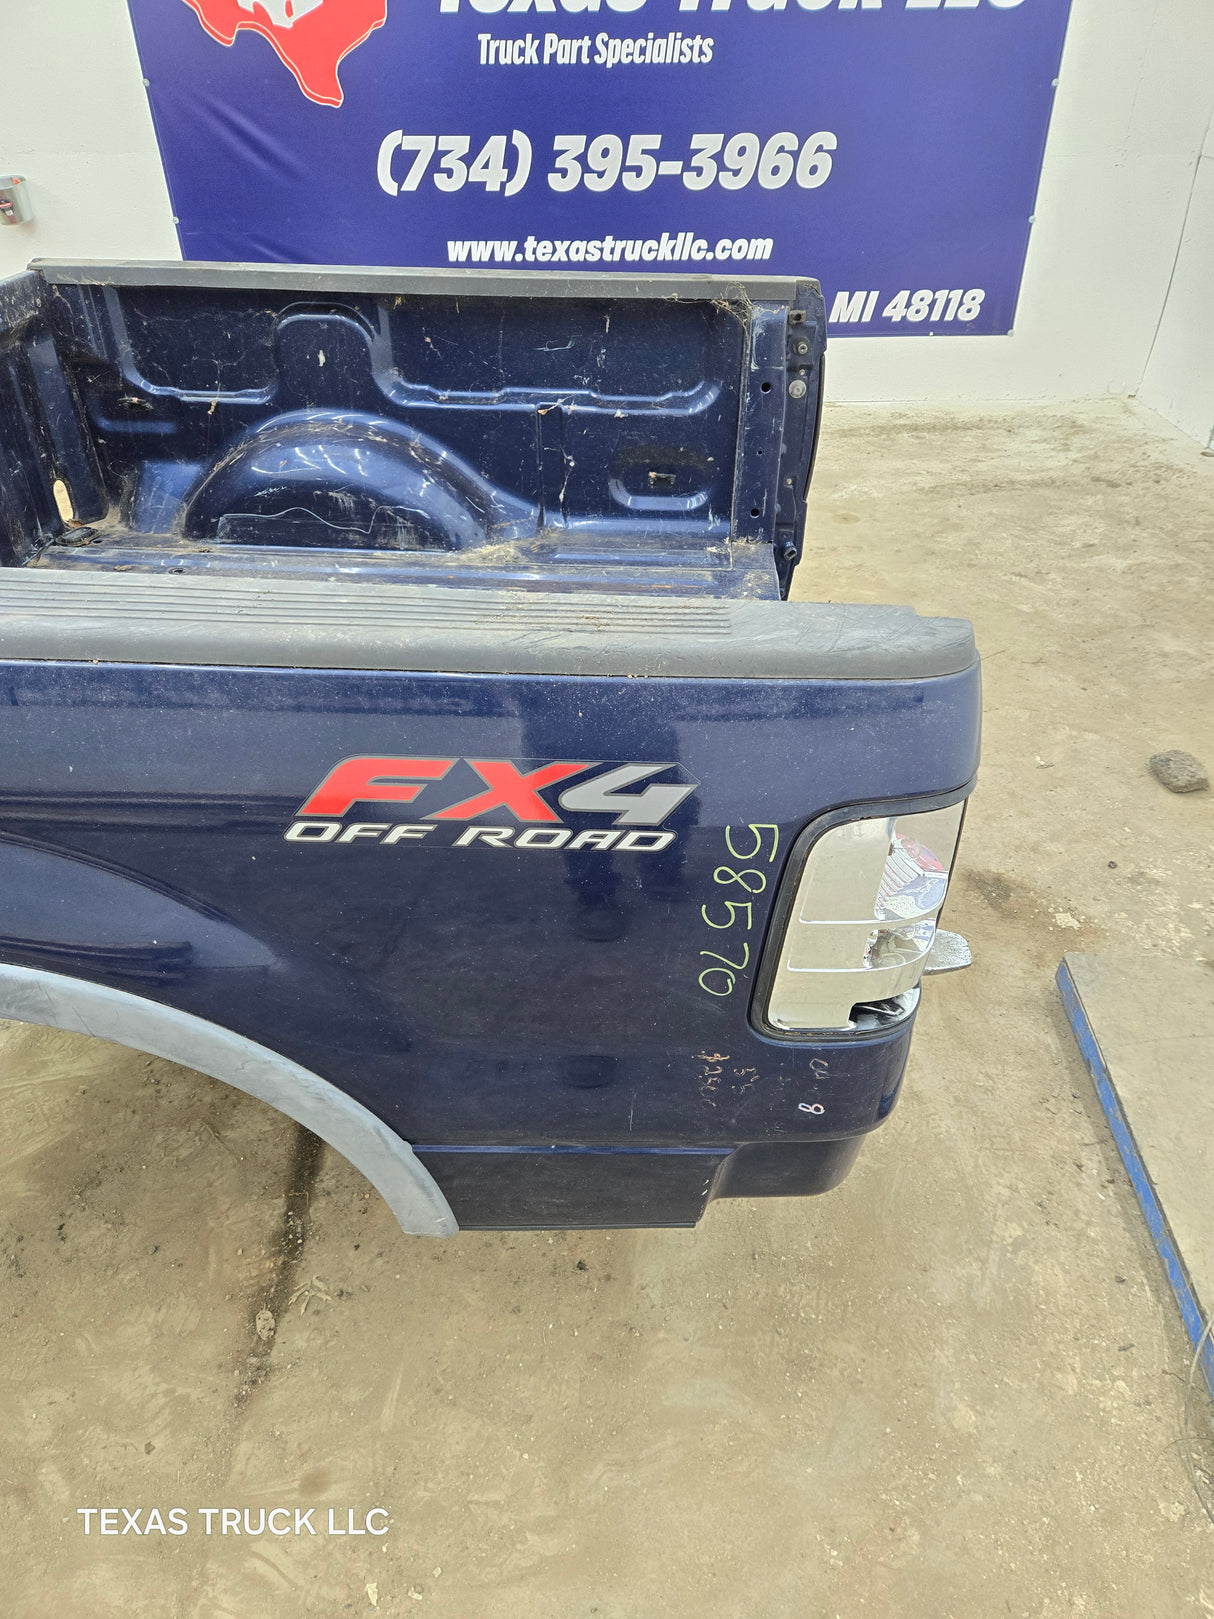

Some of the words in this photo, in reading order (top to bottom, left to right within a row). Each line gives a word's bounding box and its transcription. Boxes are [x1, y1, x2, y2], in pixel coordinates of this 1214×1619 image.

[477, 33, 539, 65] Truck
[543, 32, 591, 65] Part
[594, 32, 714, 68] Specialists
[377, 129, 533, 197] (734)
[547, 131, 838, 192] 395-3966
[446, 232, 773, 262] www.texastruckllc.com
[828, 290, 880, 323] MI
[882, 288, 986, 322] 48118
[295, 754, 698, 826] FX4
[283, 820, 438, 845] OFF
[452, 826, 679, 852] ROAD
[699, 823, 780, 996] 58570
